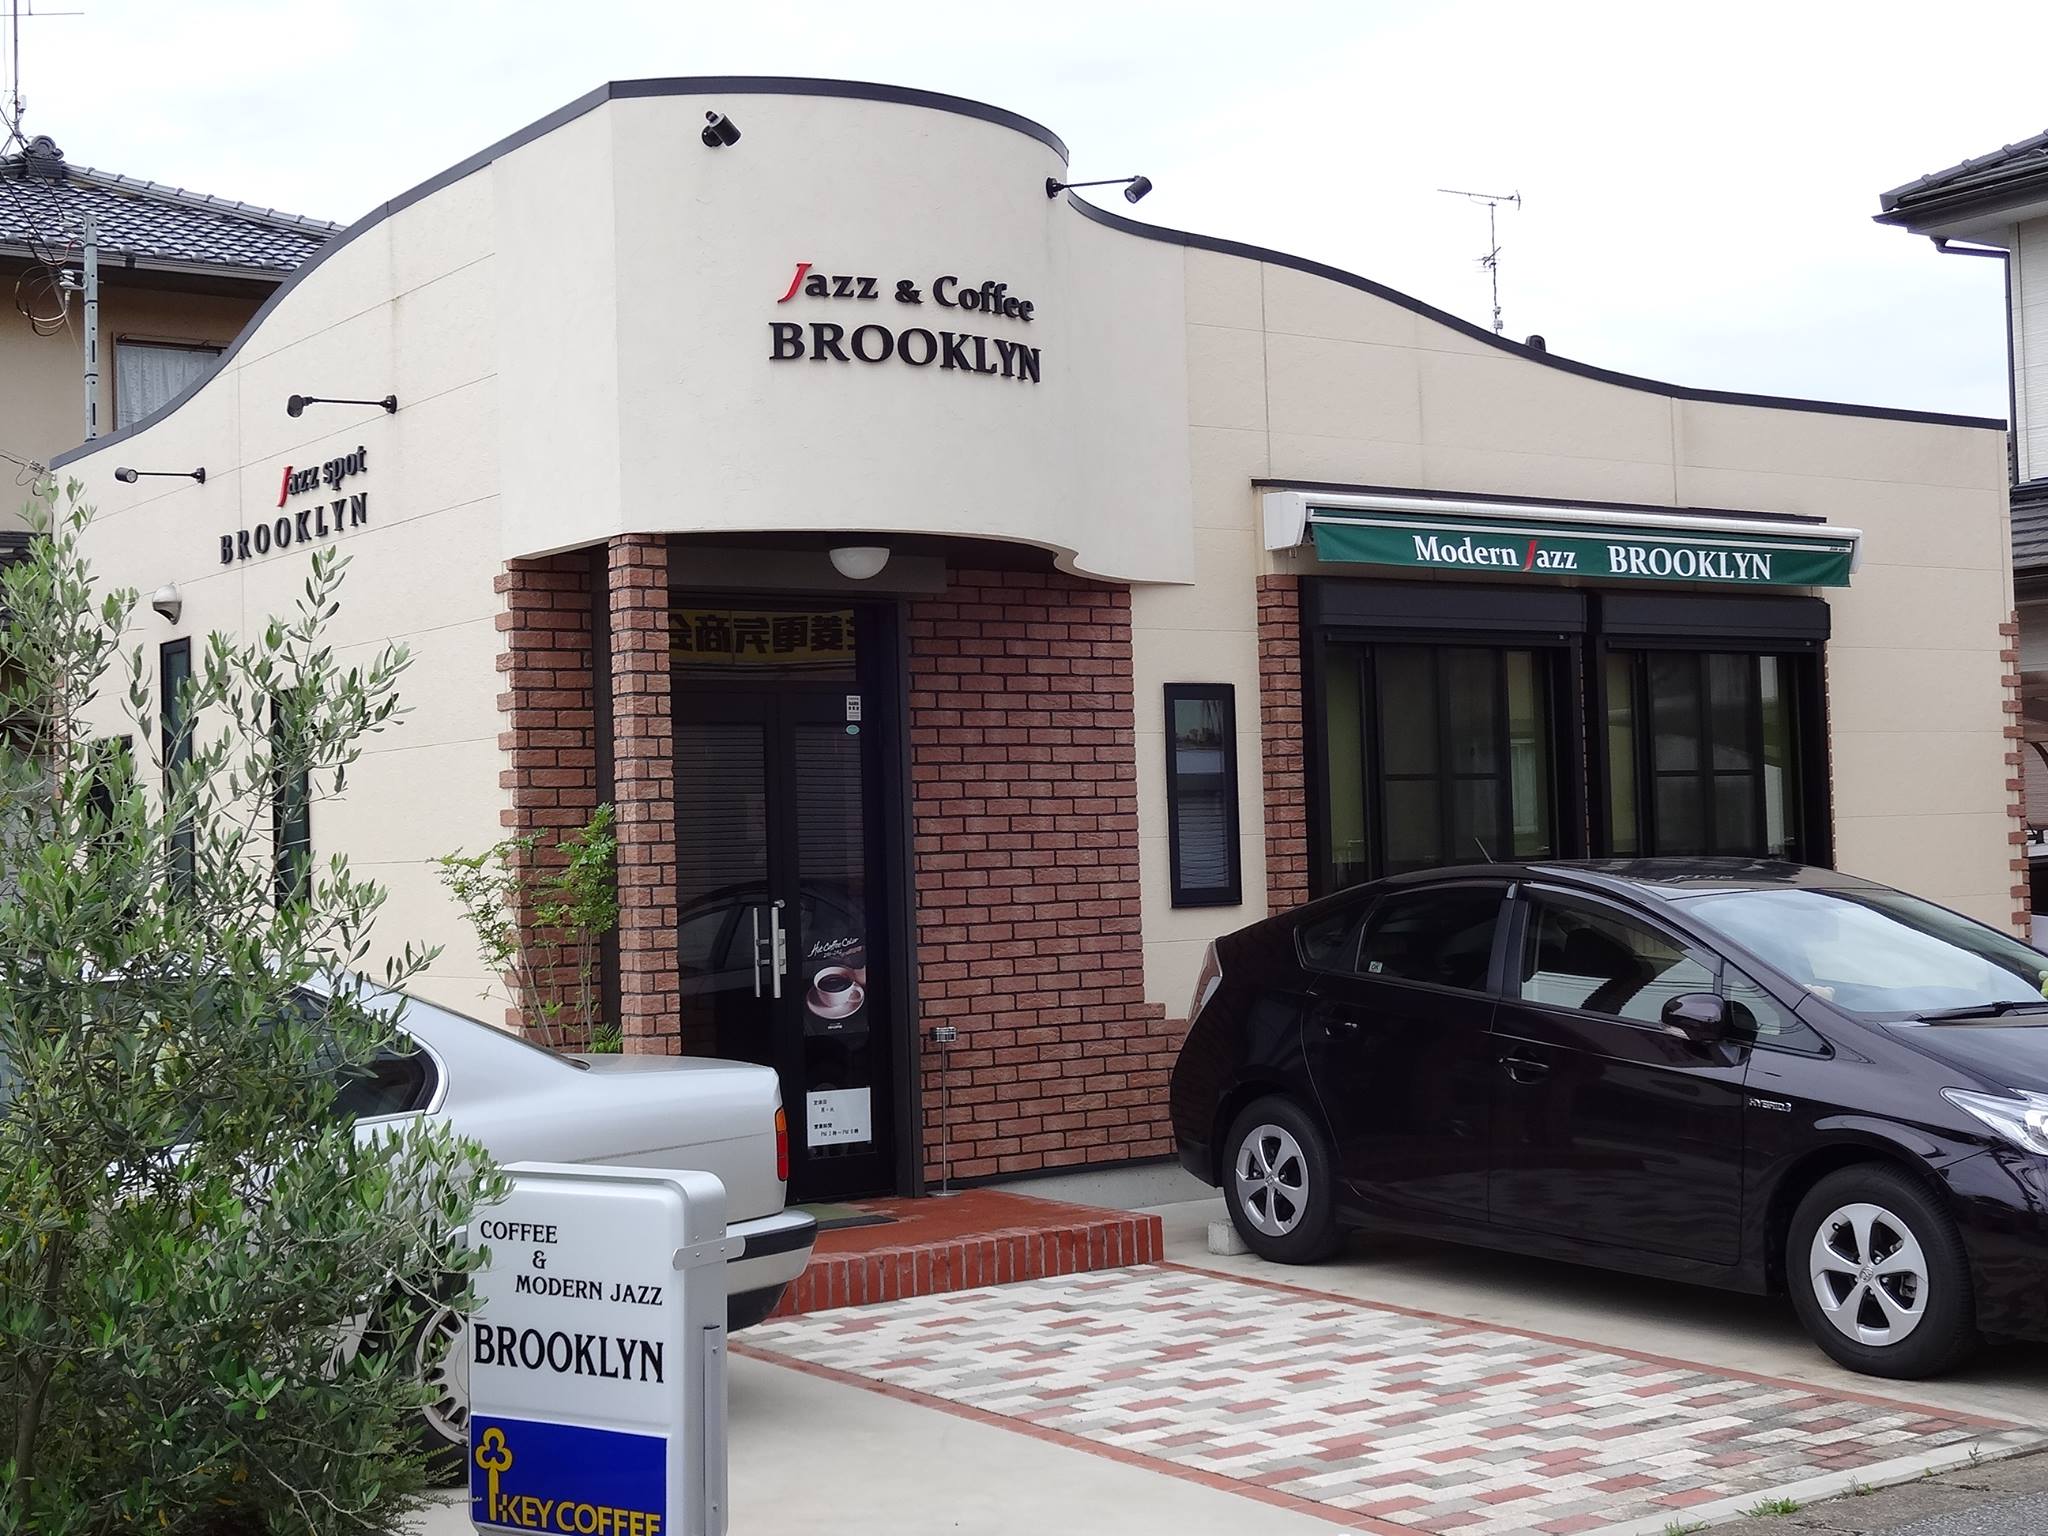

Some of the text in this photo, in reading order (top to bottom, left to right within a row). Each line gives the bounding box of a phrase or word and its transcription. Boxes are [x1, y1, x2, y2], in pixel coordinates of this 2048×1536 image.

[777, 262, 1035, 322] Jazz & Coffee
[768, 322, 1042, 384] BROOKLYN
[277, 445, 368, 508] Jazz spot
[219, 492, 368, 564] BROOKLYN
[1412, 535, 1772, 580] Modern Jazz BROOKLYN
[480, 1220, 558, 1244] COFFEE
[532, 1250, 547, 1269] &
[515, 1275, 663, 1306] MODERN JAZZ
[474, 1323, 664, 1384] BROOKLYN
[499, 1494, 661, 1536] KEY COFFEE
